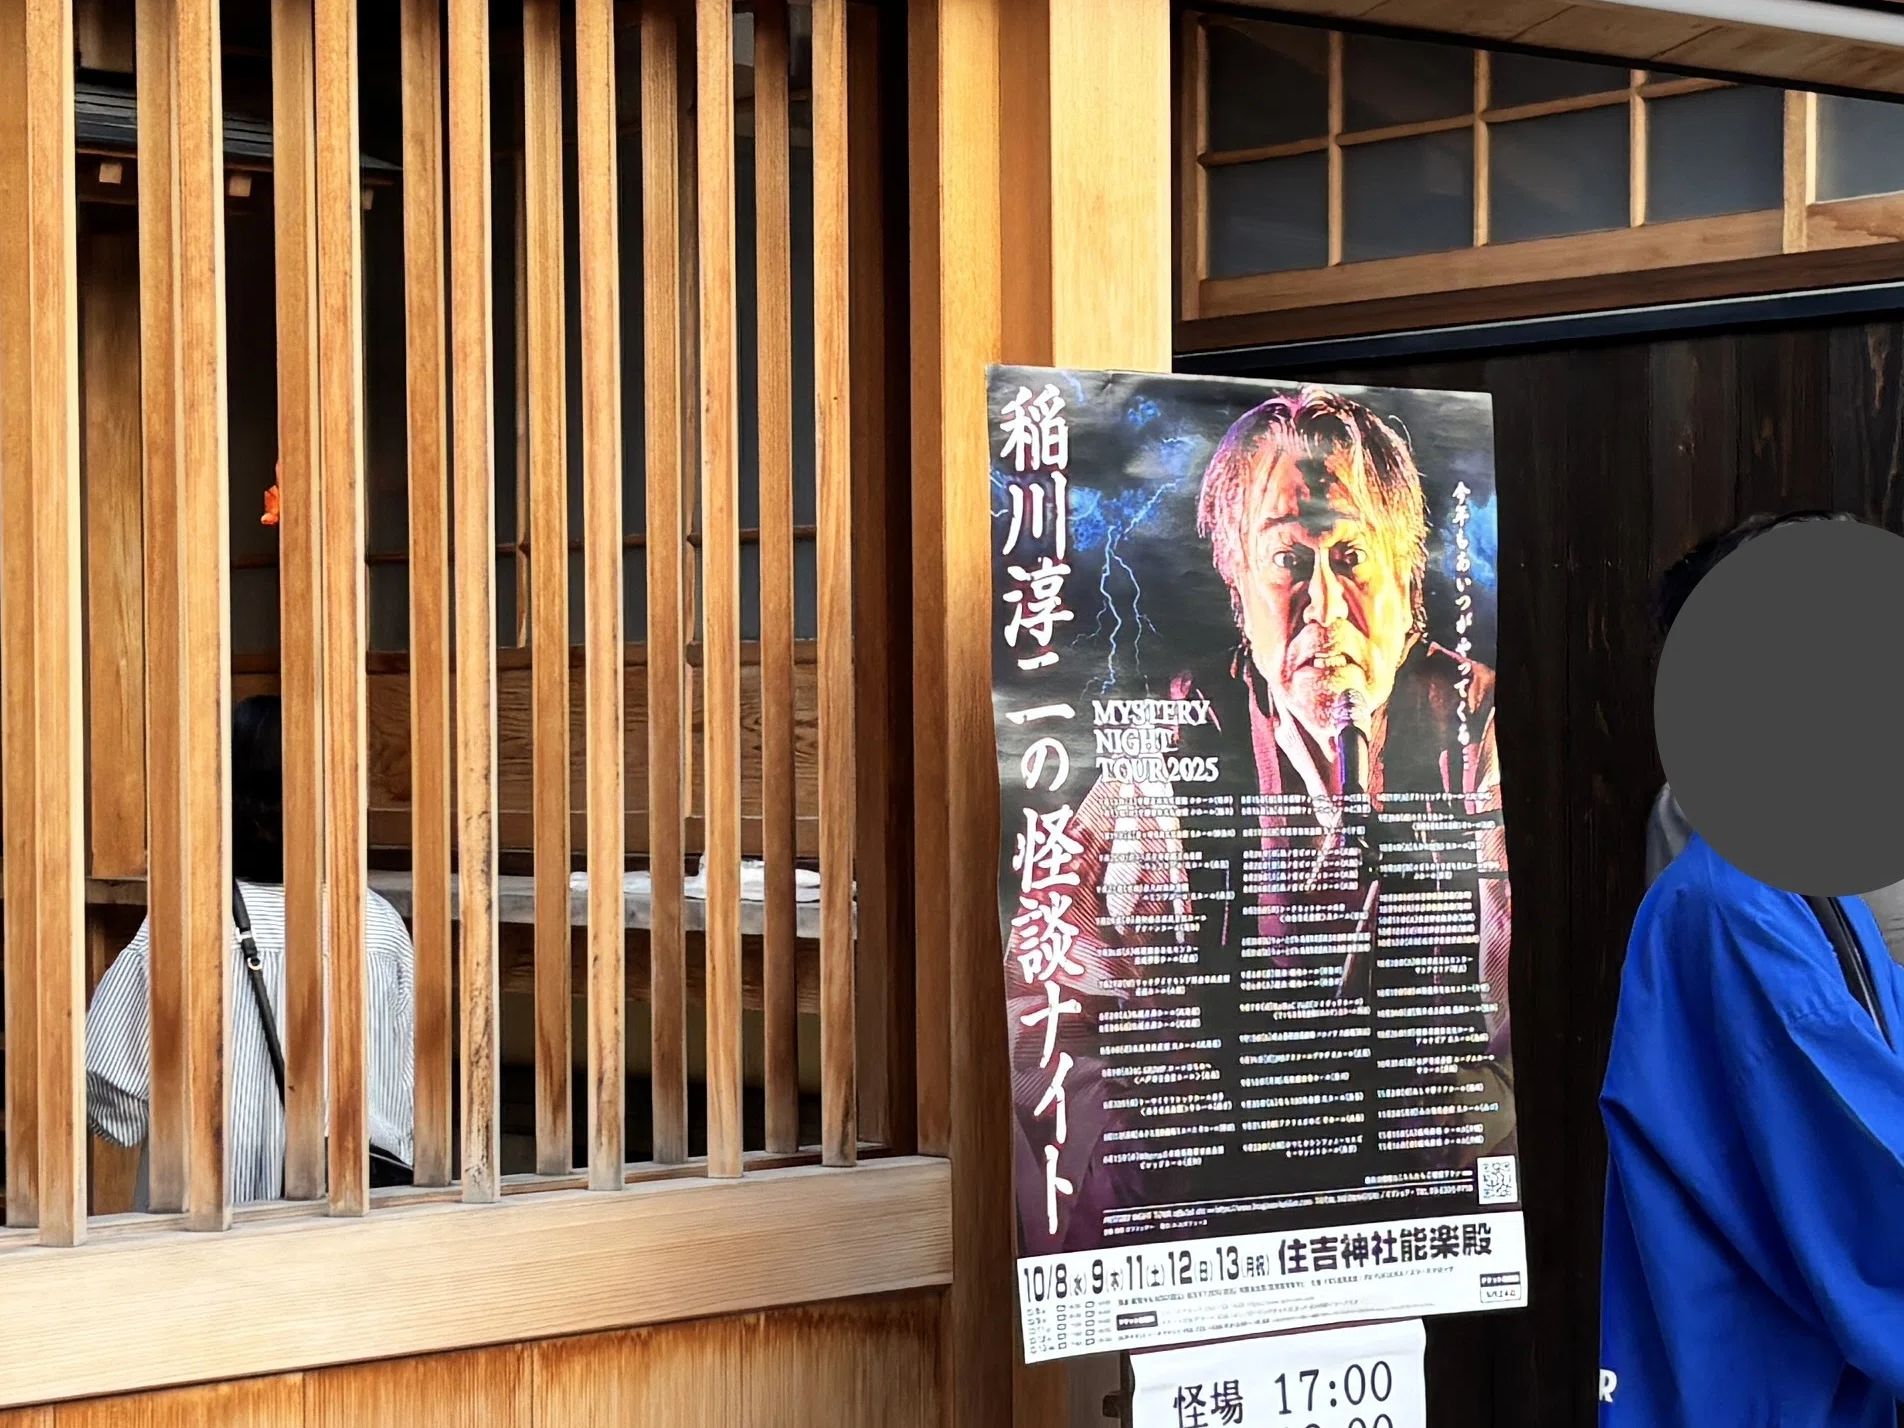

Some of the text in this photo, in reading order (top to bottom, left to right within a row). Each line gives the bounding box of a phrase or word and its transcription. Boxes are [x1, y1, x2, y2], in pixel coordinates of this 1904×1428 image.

[1092, 699, 1210, 726] MYSTERY
[1093, 728, 1179, 756] NIGHT
[998, 383, 1086, 1235] 稲川淳二の怪談ナイト
[1278, 1222, 1492, 1276] 住吉神社能楽殿
[1275, 1361, 1393, 1415] 17:00
